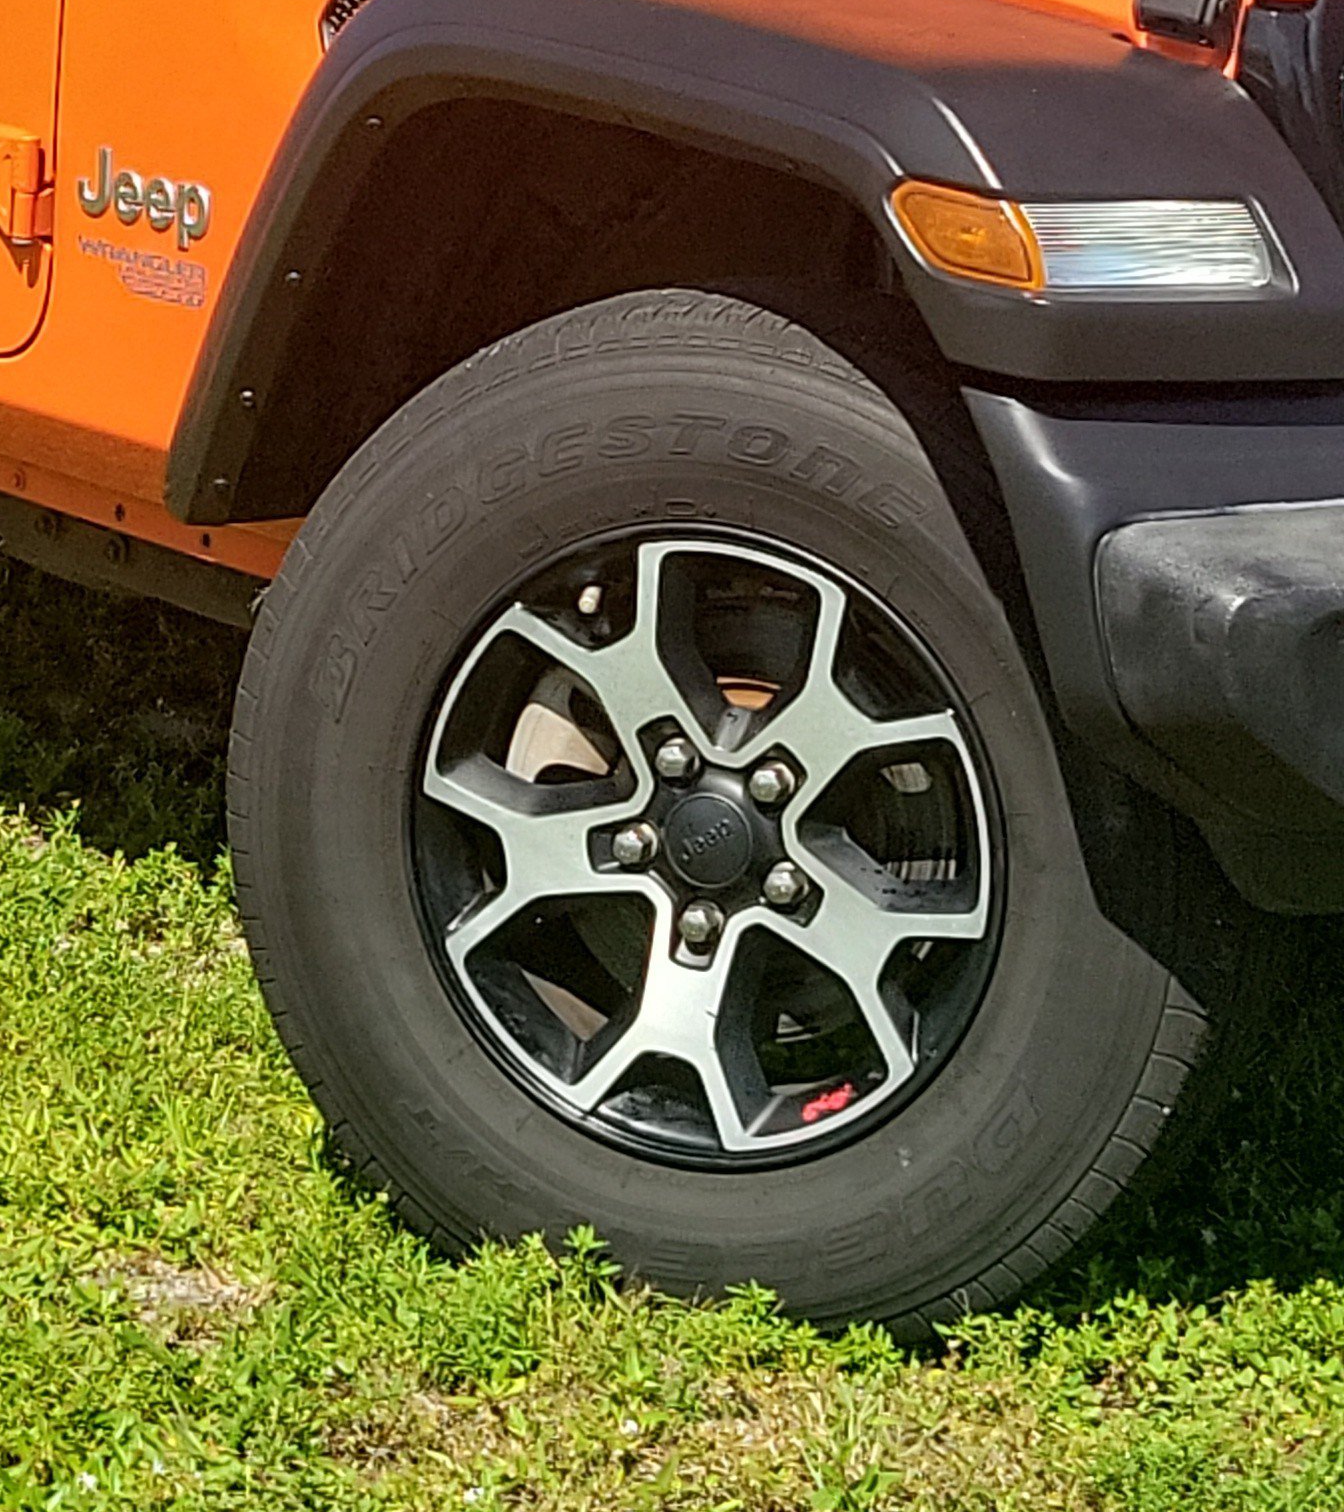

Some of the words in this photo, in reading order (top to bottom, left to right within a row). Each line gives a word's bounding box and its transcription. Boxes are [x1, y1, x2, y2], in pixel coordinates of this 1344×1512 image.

[78, 146, 211, 252] Jeep
[308, 413, 931, 728] BRIDGESTONE
[680, 817, 736, 863] Jeep
